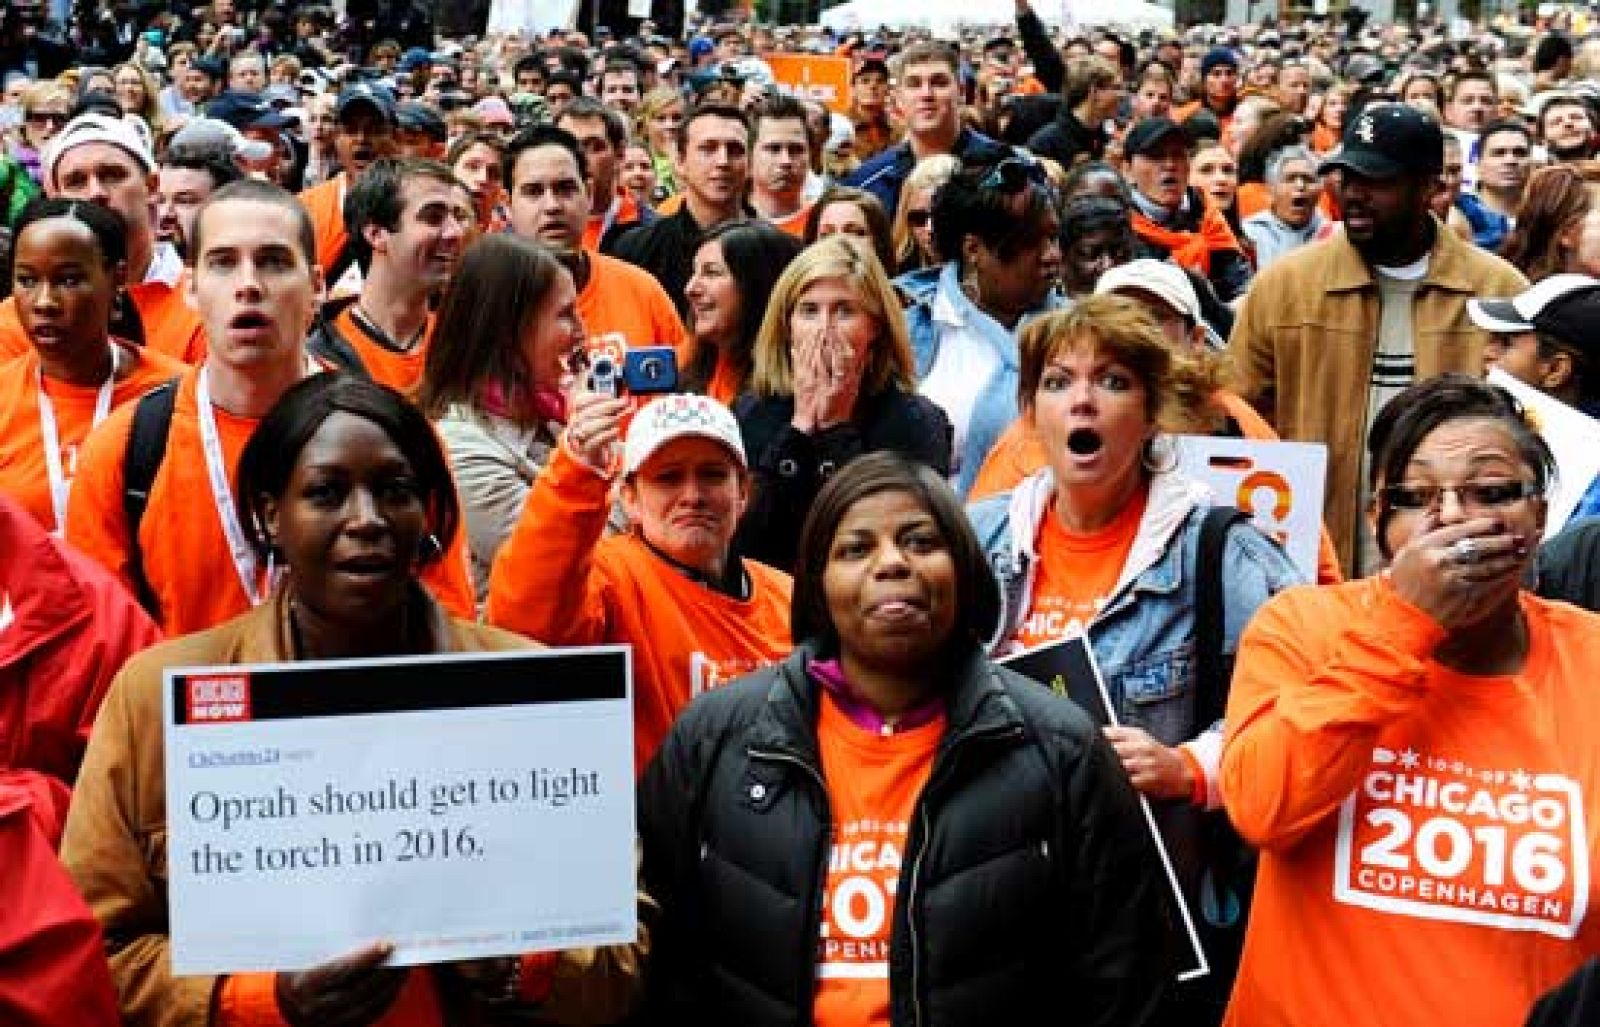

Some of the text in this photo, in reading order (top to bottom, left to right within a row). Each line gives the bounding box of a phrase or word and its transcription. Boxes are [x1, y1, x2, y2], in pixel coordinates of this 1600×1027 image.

[191, 702, 246, 720] NOW
[190, 766, 600, 831] Oprah should get to light
[1363, 770, 1566, 828] CHICAGO
[191, 825, 484, 876] the torch in 2016.
[1360, 808, 1567, 894] 2016
[1357, 869, 1563, 918] COPENHAGEN
